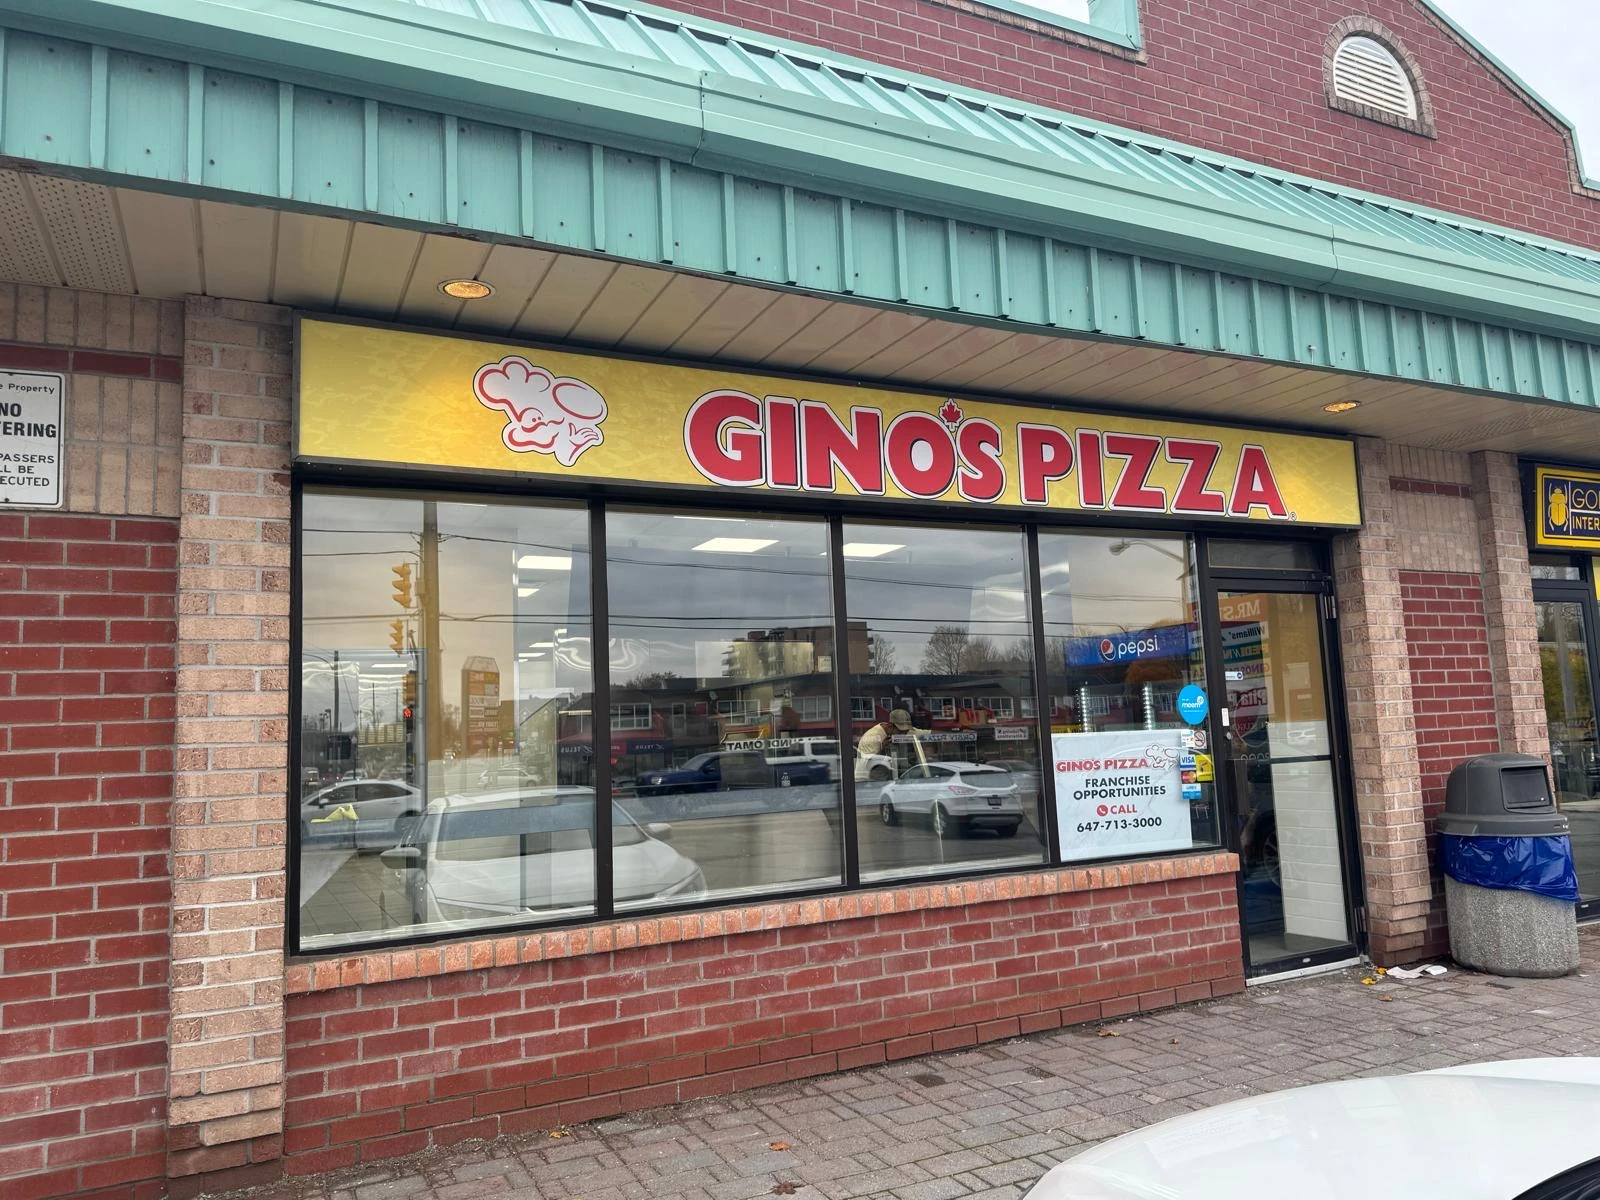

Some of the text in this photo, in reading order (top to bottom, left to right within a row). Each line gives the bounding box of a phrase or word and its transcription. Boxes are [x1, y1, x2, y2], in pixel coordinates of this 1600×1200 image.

[8, 382, 55, 395] Property
[0, 402, 22, 417] NO
[683, 389, 1290, 520] GINO'S PIZZA
[18, 465, 35, 475] BE
[1117, 634, 1158, 659] pepsi
[1056, 758, 1149, 772] GINO'S PIZZA
[1085, 776, 1151, 788] FRANCHISE
[1073, 785, 1167, 800] OPPORTUNITIES
[1110, 804, 1138, 815] CALL
[1077, 817, 1162, 833] 647-713-3000
